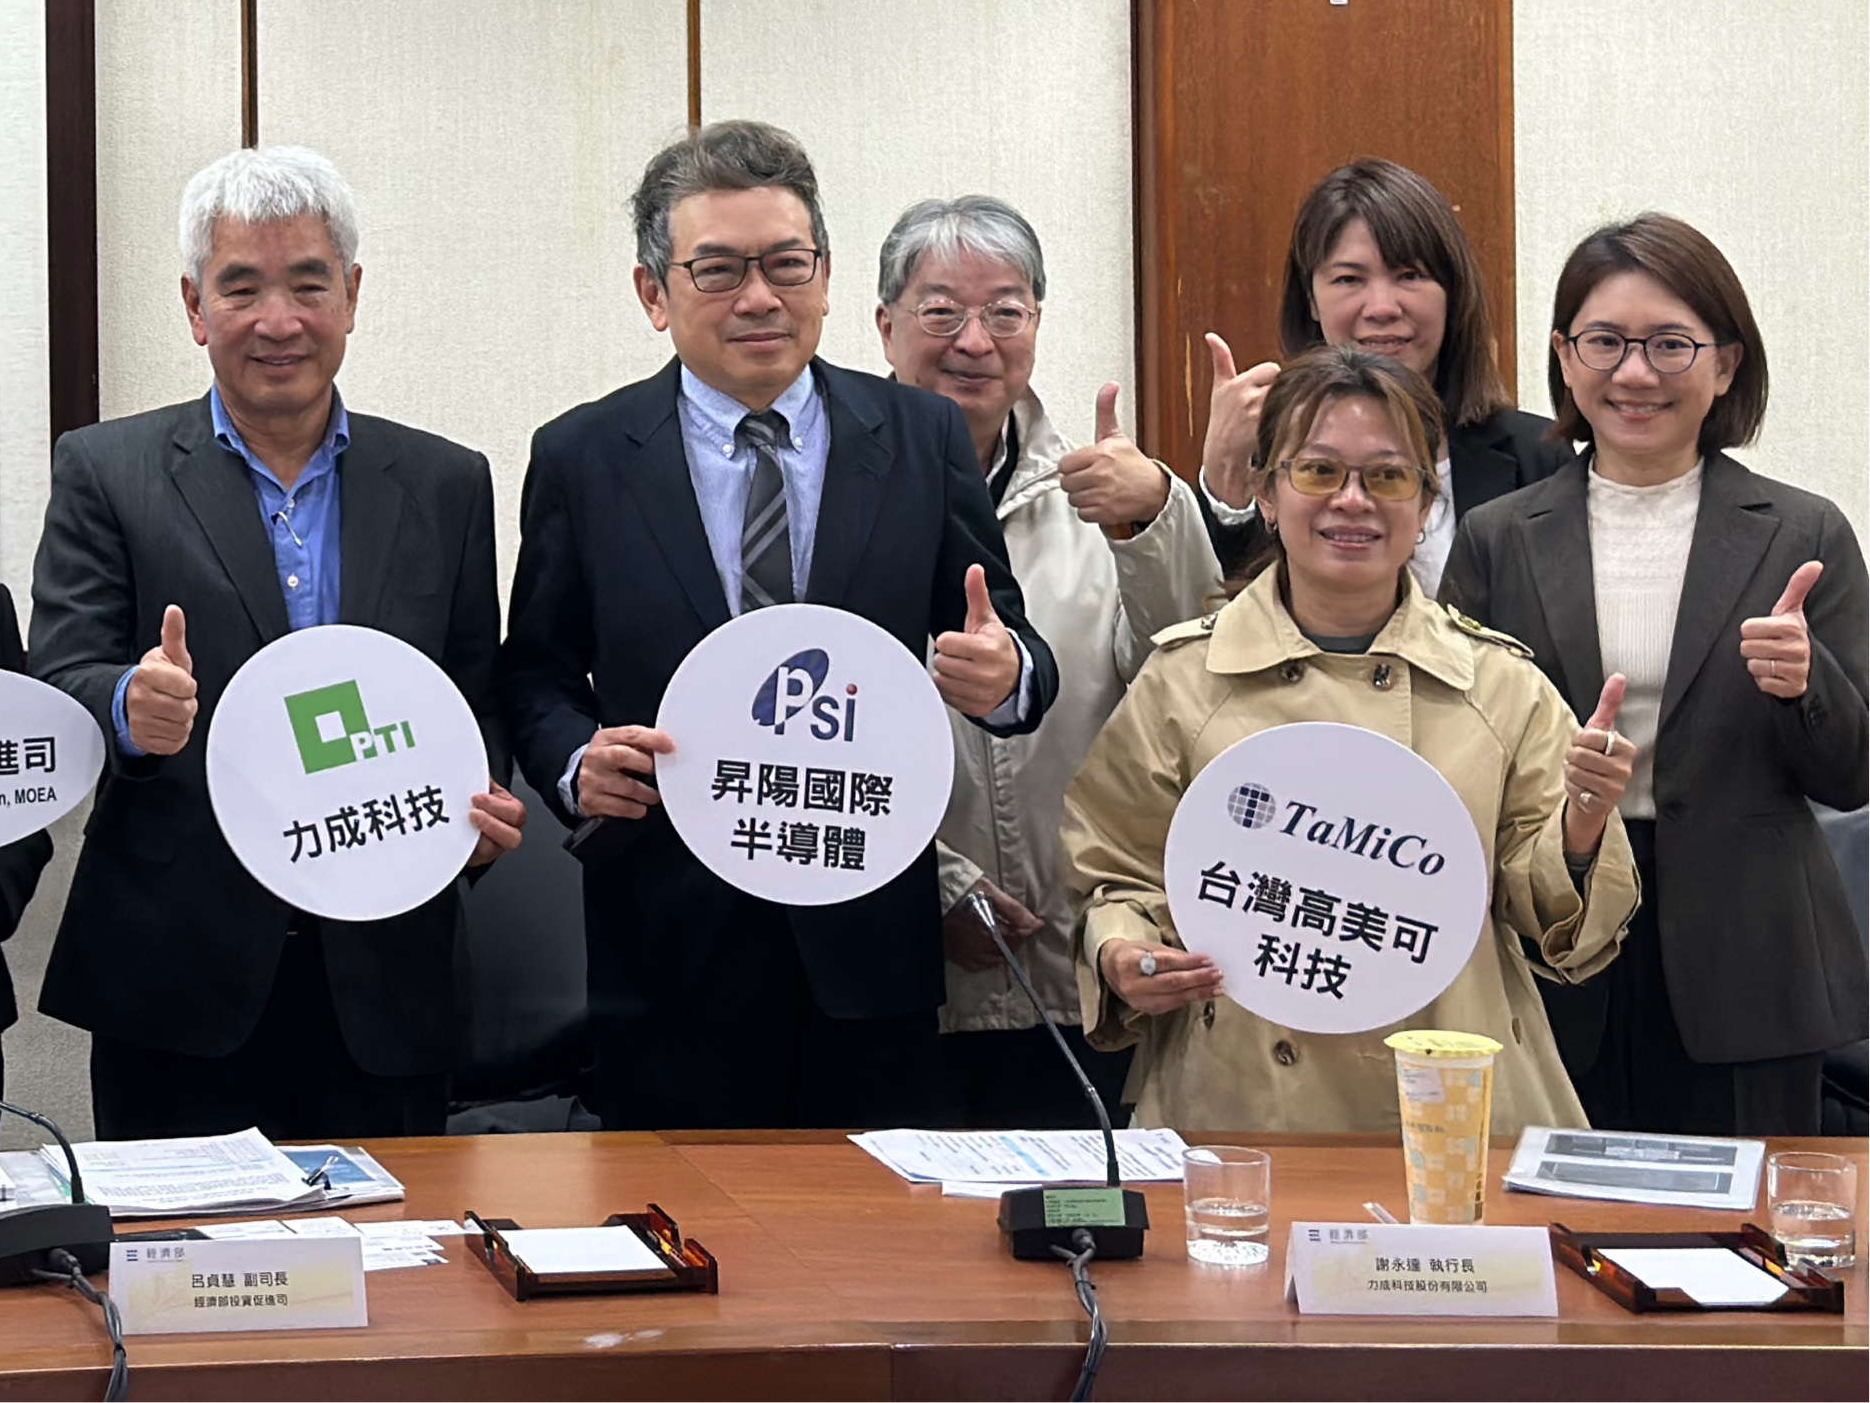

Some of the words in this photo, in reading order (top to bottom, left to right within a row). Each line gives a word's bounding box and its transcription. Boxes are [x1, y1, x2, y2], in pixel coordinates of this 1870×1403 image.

[348, 720, 417, 762] PTI
[14, 786, 58, 804] MOEA
[711, 759, 895, 817] 昇陽國際
[282, 785, 451, 864] 力成科技
[730, 817, 867, 871] 半導體
[1278, 800, 1446, 877] TaMiCo
[1197, 860, 1440, 965] 台灣高美可
[1253, 933, 1352, 1000] 科技
[192, 1273, 236, 1288] 呂貞慧
[243, 1271, 289, 1287] 副司長
[1367, 1279, 1488, 1293] 力成科技股份有限公司
[1429, 1258, 1475, 1273] 執行長
[194, 1294, 288, 1308] 經濟部投資促進司
